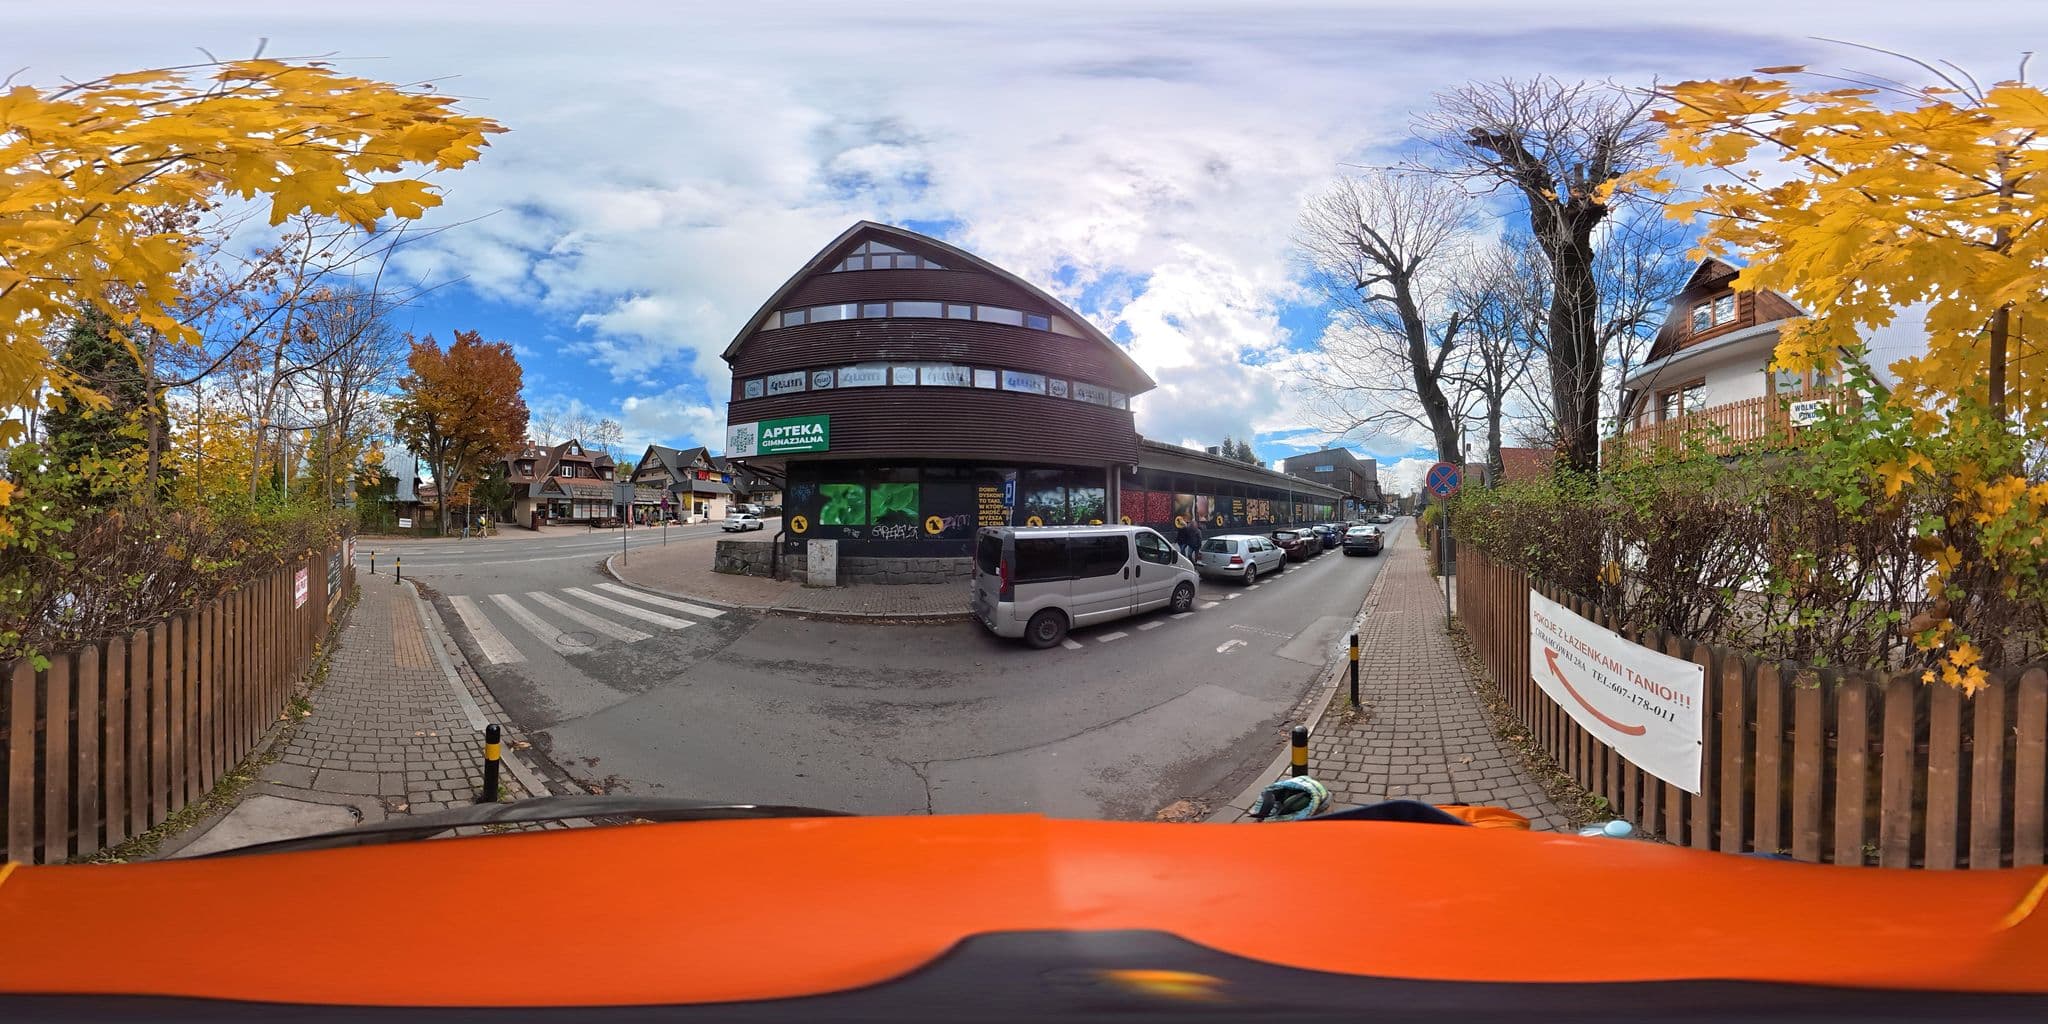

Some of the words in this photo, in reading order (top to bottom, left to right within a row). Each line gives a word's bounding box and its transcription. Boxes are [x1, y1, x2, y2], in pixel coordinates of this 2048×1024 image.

[762, 423, 824, 439] APTEKA
[762, 435, 824, 447] GIMNAZJALNA
[1533, 610, 1557, 634] POKOJE
[1558, 627, 1564, 638] Z
[1564, 631, 1622, 676] ŁAZIENKAMI
[1626, 667, 1690, 709] TANIO!!!
